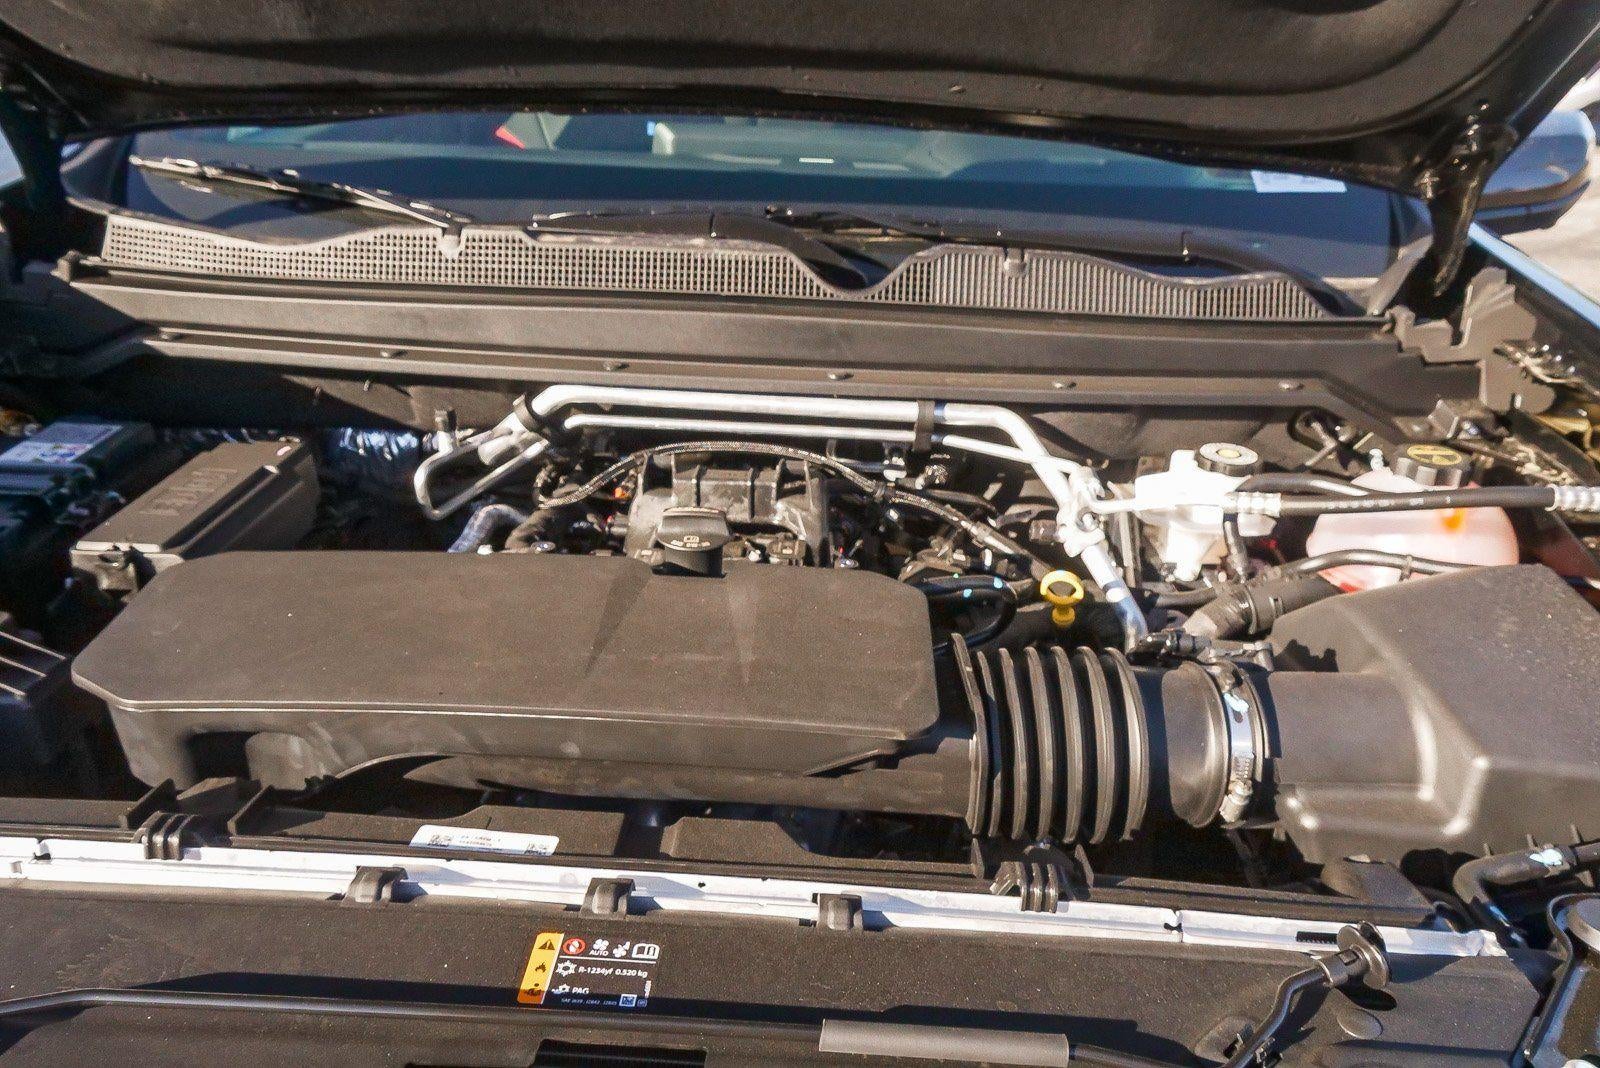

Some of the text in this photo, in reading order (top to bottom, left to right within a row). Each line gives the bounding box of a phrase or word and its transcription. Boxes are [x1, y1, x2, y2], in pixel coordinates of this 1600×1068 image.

[589, 949, 609, 957] AUTO
[578, 966, 614, 977] R-1234yf
[637, 969, 648, 979] kg
